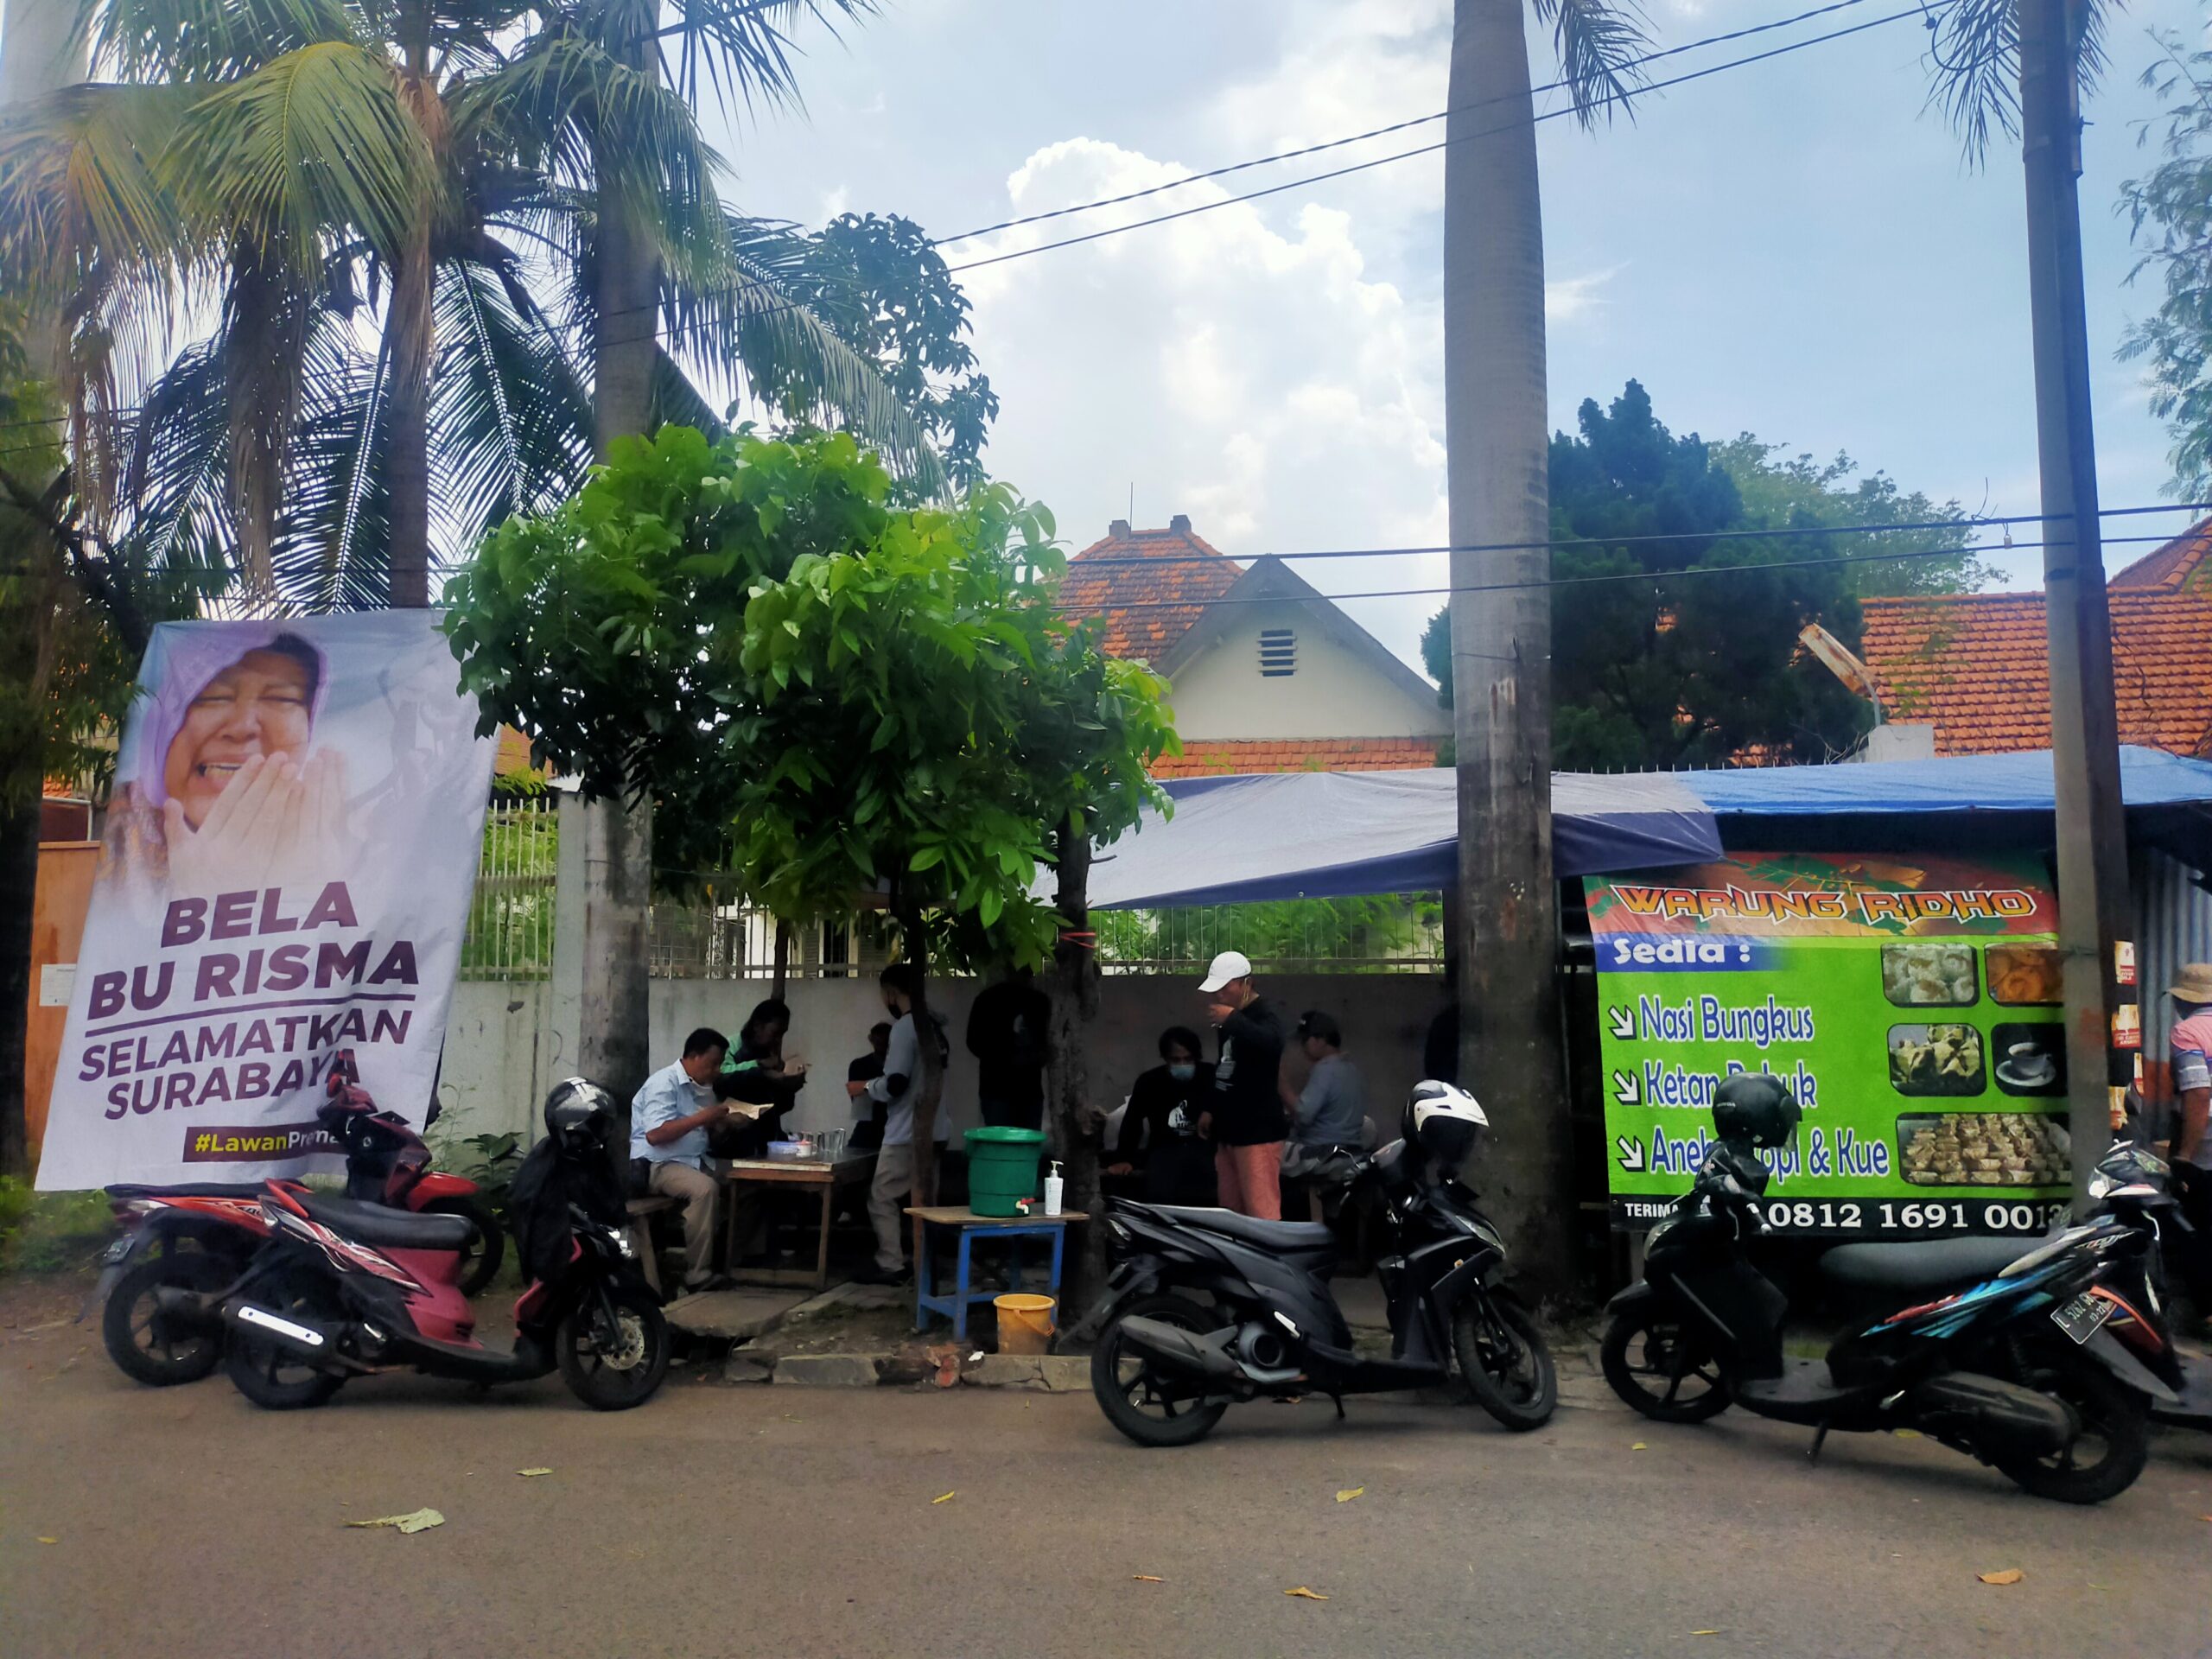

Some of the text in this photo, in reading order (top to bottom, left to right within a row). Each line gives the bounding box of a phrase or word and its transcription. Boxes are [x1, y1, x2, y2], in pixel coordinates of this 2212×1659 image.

[161, 881, 359, 948] BELA
[1610, 883, 2037, 925] WARUNG RIDHO
[1613, 938, 1726, 964] Sedia
[87, 940, 419, 1020] BU RISMA
[79, 1008, 412, 1082] SELAMATKAN
[1639, 995, 1815, 1048] Nasi Bungkus
[1808, 1127, 1831, 1177] &
[1835, 1127, 1890, 1177] Kue
[1768, 1202, 1862, 1228] 0812
[1878, 1203, 1969, 1229] 1691
